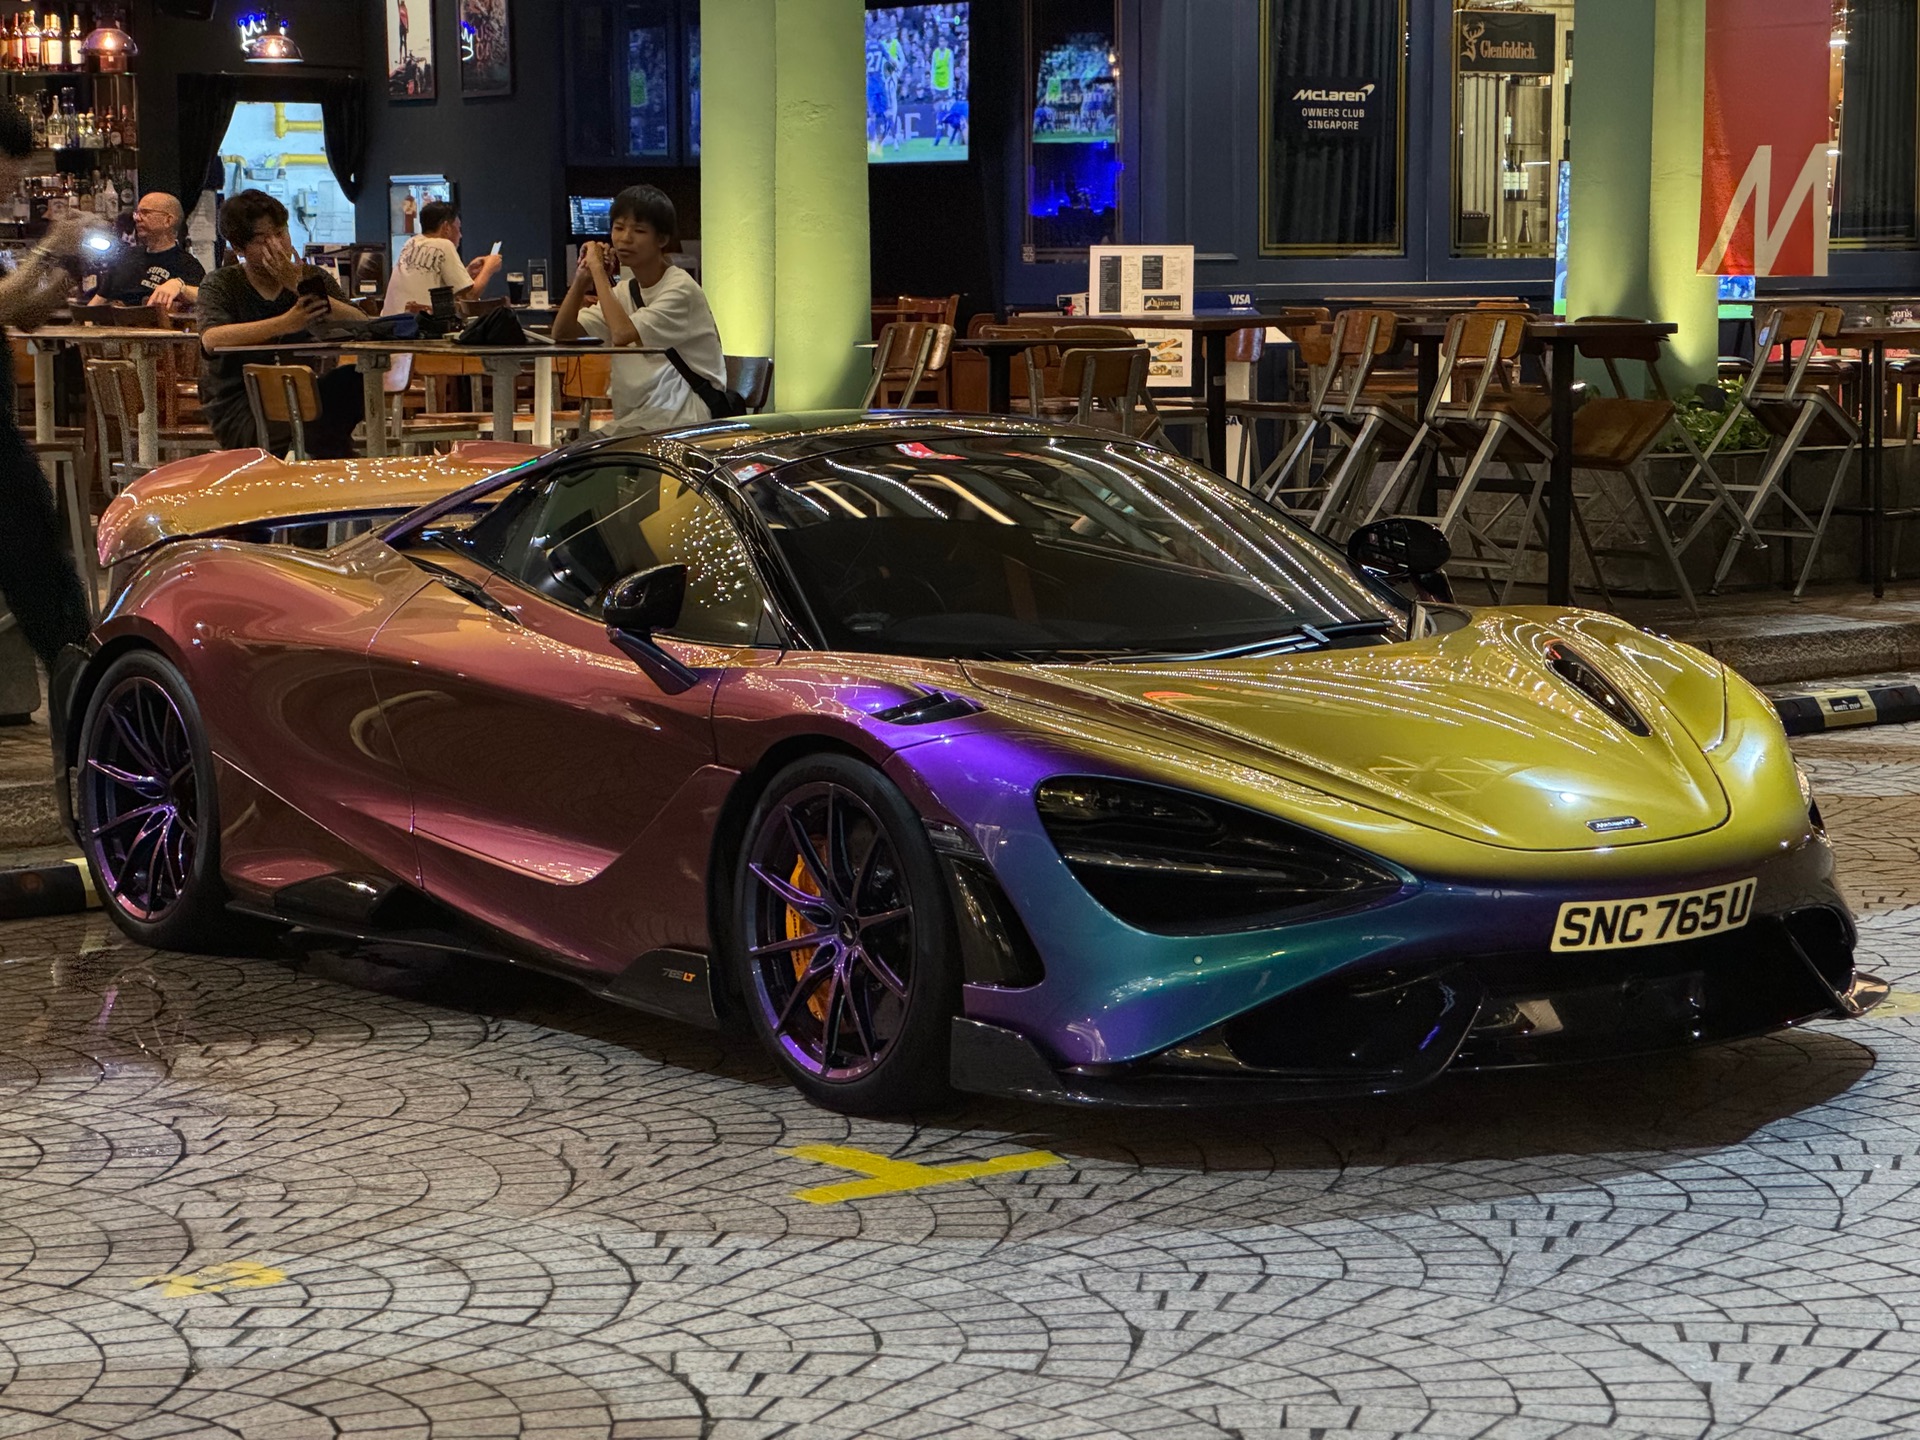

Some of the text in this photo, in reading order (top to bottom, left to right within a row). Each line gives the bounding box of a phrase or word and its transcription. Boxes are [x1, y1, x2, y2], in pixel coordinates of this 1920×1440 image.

[1480, 40, 1536, 59] Glenfiddich
[866, 51, 882, 72] 27
[1292, 87, 1369, 102] McLaren
[1301, 107, 1365, 118] OWNERS CLUB
[1307, 120, 1360, 130] SINGAPORE
[1228, 294, 1251, 305] VISA
[1559, 883, 1753, 947] SNC 765U
